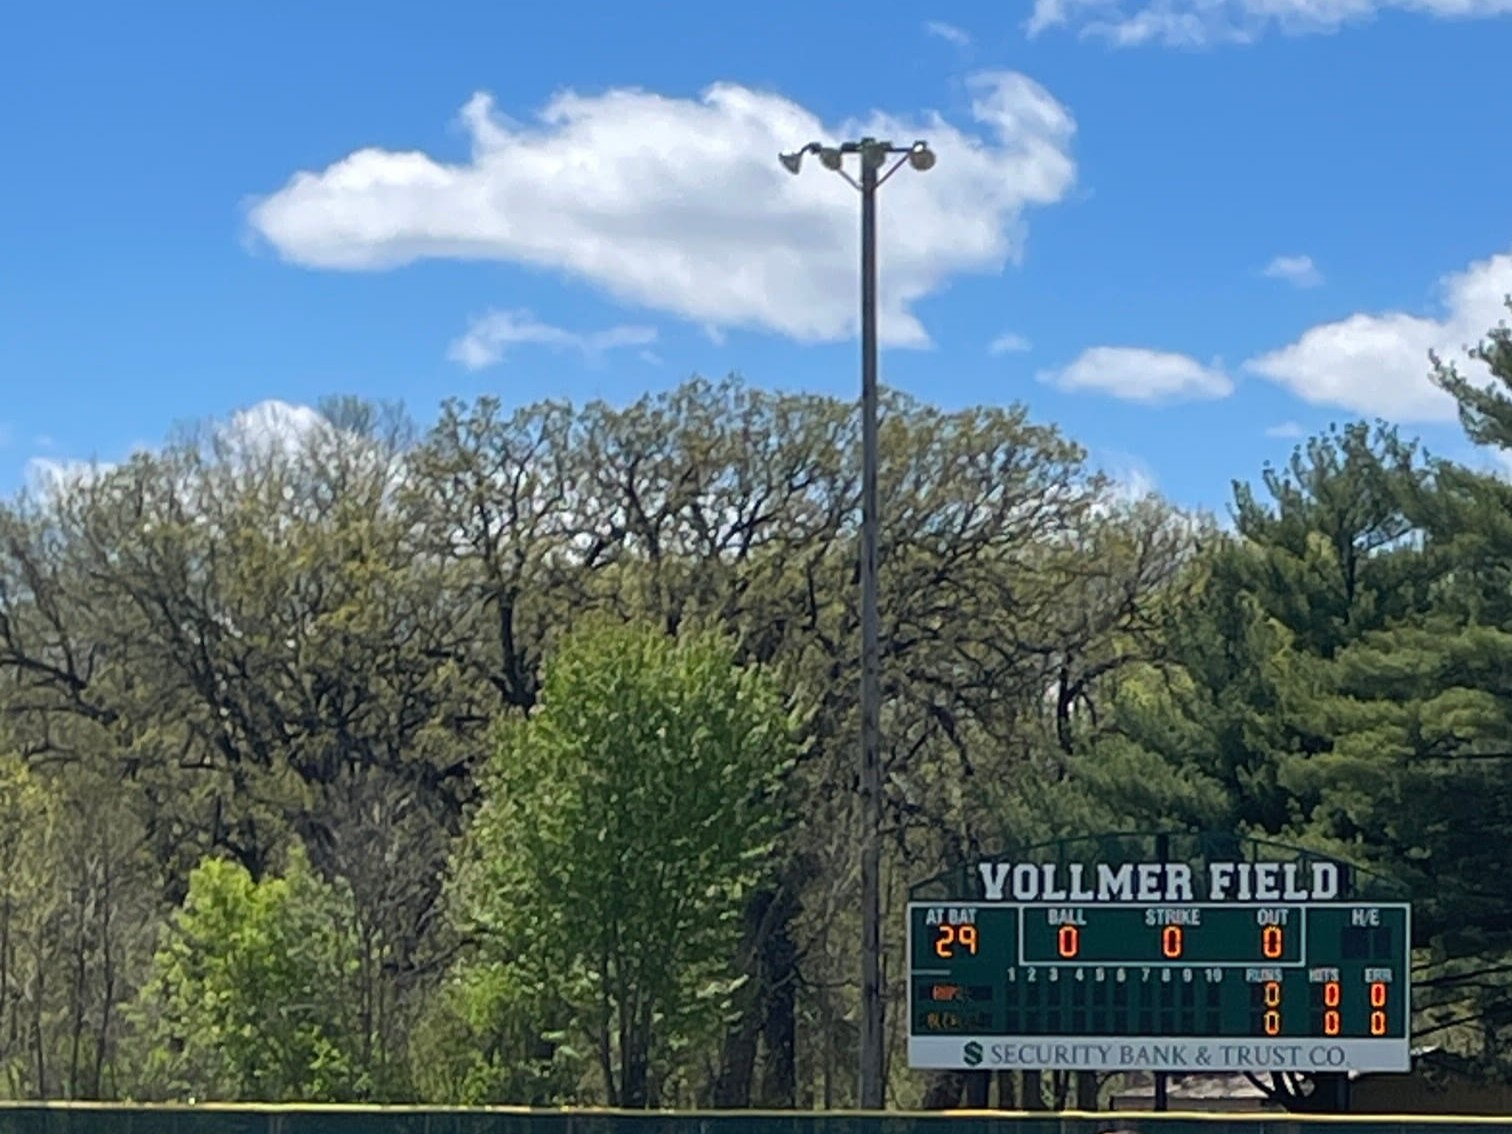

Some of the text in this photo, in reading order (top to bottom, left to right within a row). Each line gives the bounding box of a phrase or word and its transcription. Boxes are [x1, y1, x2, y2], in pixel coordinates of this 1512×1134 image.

[979, 862, 1338, 900] VOLLMER FIELD
[926, 909, 978, 925] AT BAT
[1048, 908, 1086, 926] BALL
[1145, 909, 1200, 926] STRIKE
[1257, 909, 1289, 925] OUT
[1352, 909, 1380, 926] H/E
[935, 925, 977, 958] 29
[1059, 925, 1078, 957] 0
[1163, 926, 1182, 957] 0
[1263, 925, 1282, 957] 0
[1008, 967, 1016, 982] 1
[1028, 967, 1037, 982] 2
[1049, 967, 1058, 982] 3
[1075, 967, 1084, 982] 4
[1117, 967, 1126, 982] 6
[1142, 967, 1150, 982] 7
[1161, 967, 1171, 982] 8
[1182, 967, 1192, 982] 9
[1205, 967, 1223, 982] 10
[1264, 982, 1279, 1007] 0
[1325, 982, 1339, 1007] 0
[1371, 982, 1385, 1007] 0
[1264, 1010, 1279, 1035] 0
[1325, 1010, 1339, 1035] 0
[1371, 1010, 1385, 1035] 0
[991, 1044, 1113, 1065] SECURITY
[1119, 1045, 1187, 1065] BANK
[1195, 1046, 1211, 1066] &
[1219, 1046, 1303, 1066] TRUST
[1309, 1047, 1350, 1067] CO.
